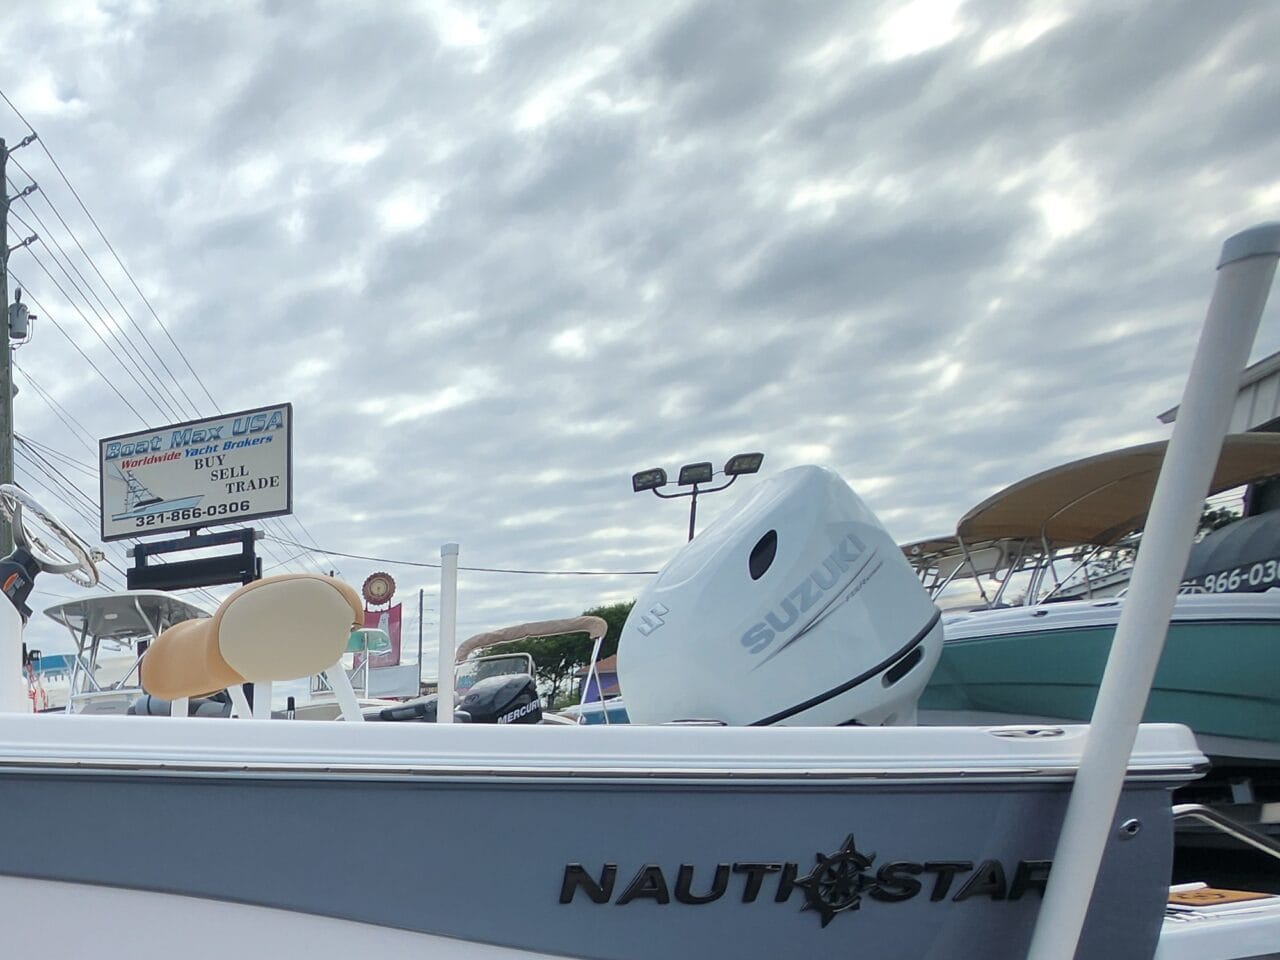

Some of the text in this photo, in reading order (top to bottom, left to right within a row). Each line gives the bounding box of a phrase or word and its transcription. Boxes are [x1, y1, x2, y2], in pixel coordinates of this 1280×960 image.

[105, 410, 284, 460] Boat Max USA
[121, 434, 273, 470] Worldwide Yacht Brokers
[194, 454, 226, 470] BUY
[210, 465, 250, 482] SELL
[225, 475, 280, 494] TRADE
[136, 500, 251, 528] 321-866-0306
[740, 533, 868, 655] SUZUKI
[497, 699, 540, 724] MERCURY
